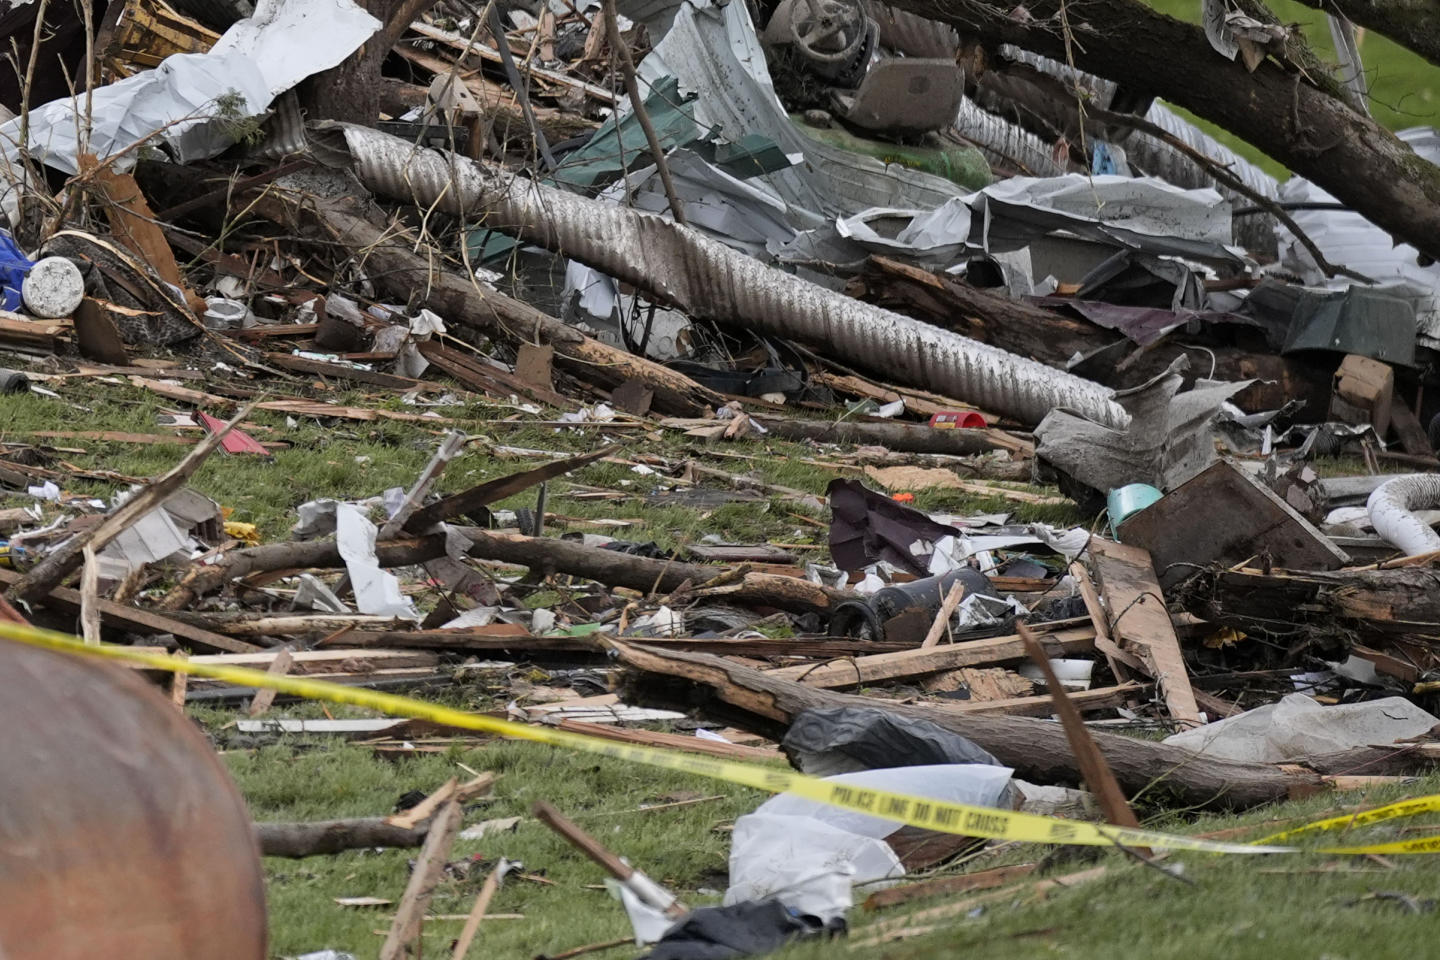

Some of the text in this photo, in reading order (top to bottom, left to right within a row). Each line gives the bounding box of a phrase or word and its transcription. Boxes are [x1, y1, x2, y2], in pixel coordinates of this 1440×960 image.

[831, 785, 1009, 835] POLICE LINE DO NOT CROSS
